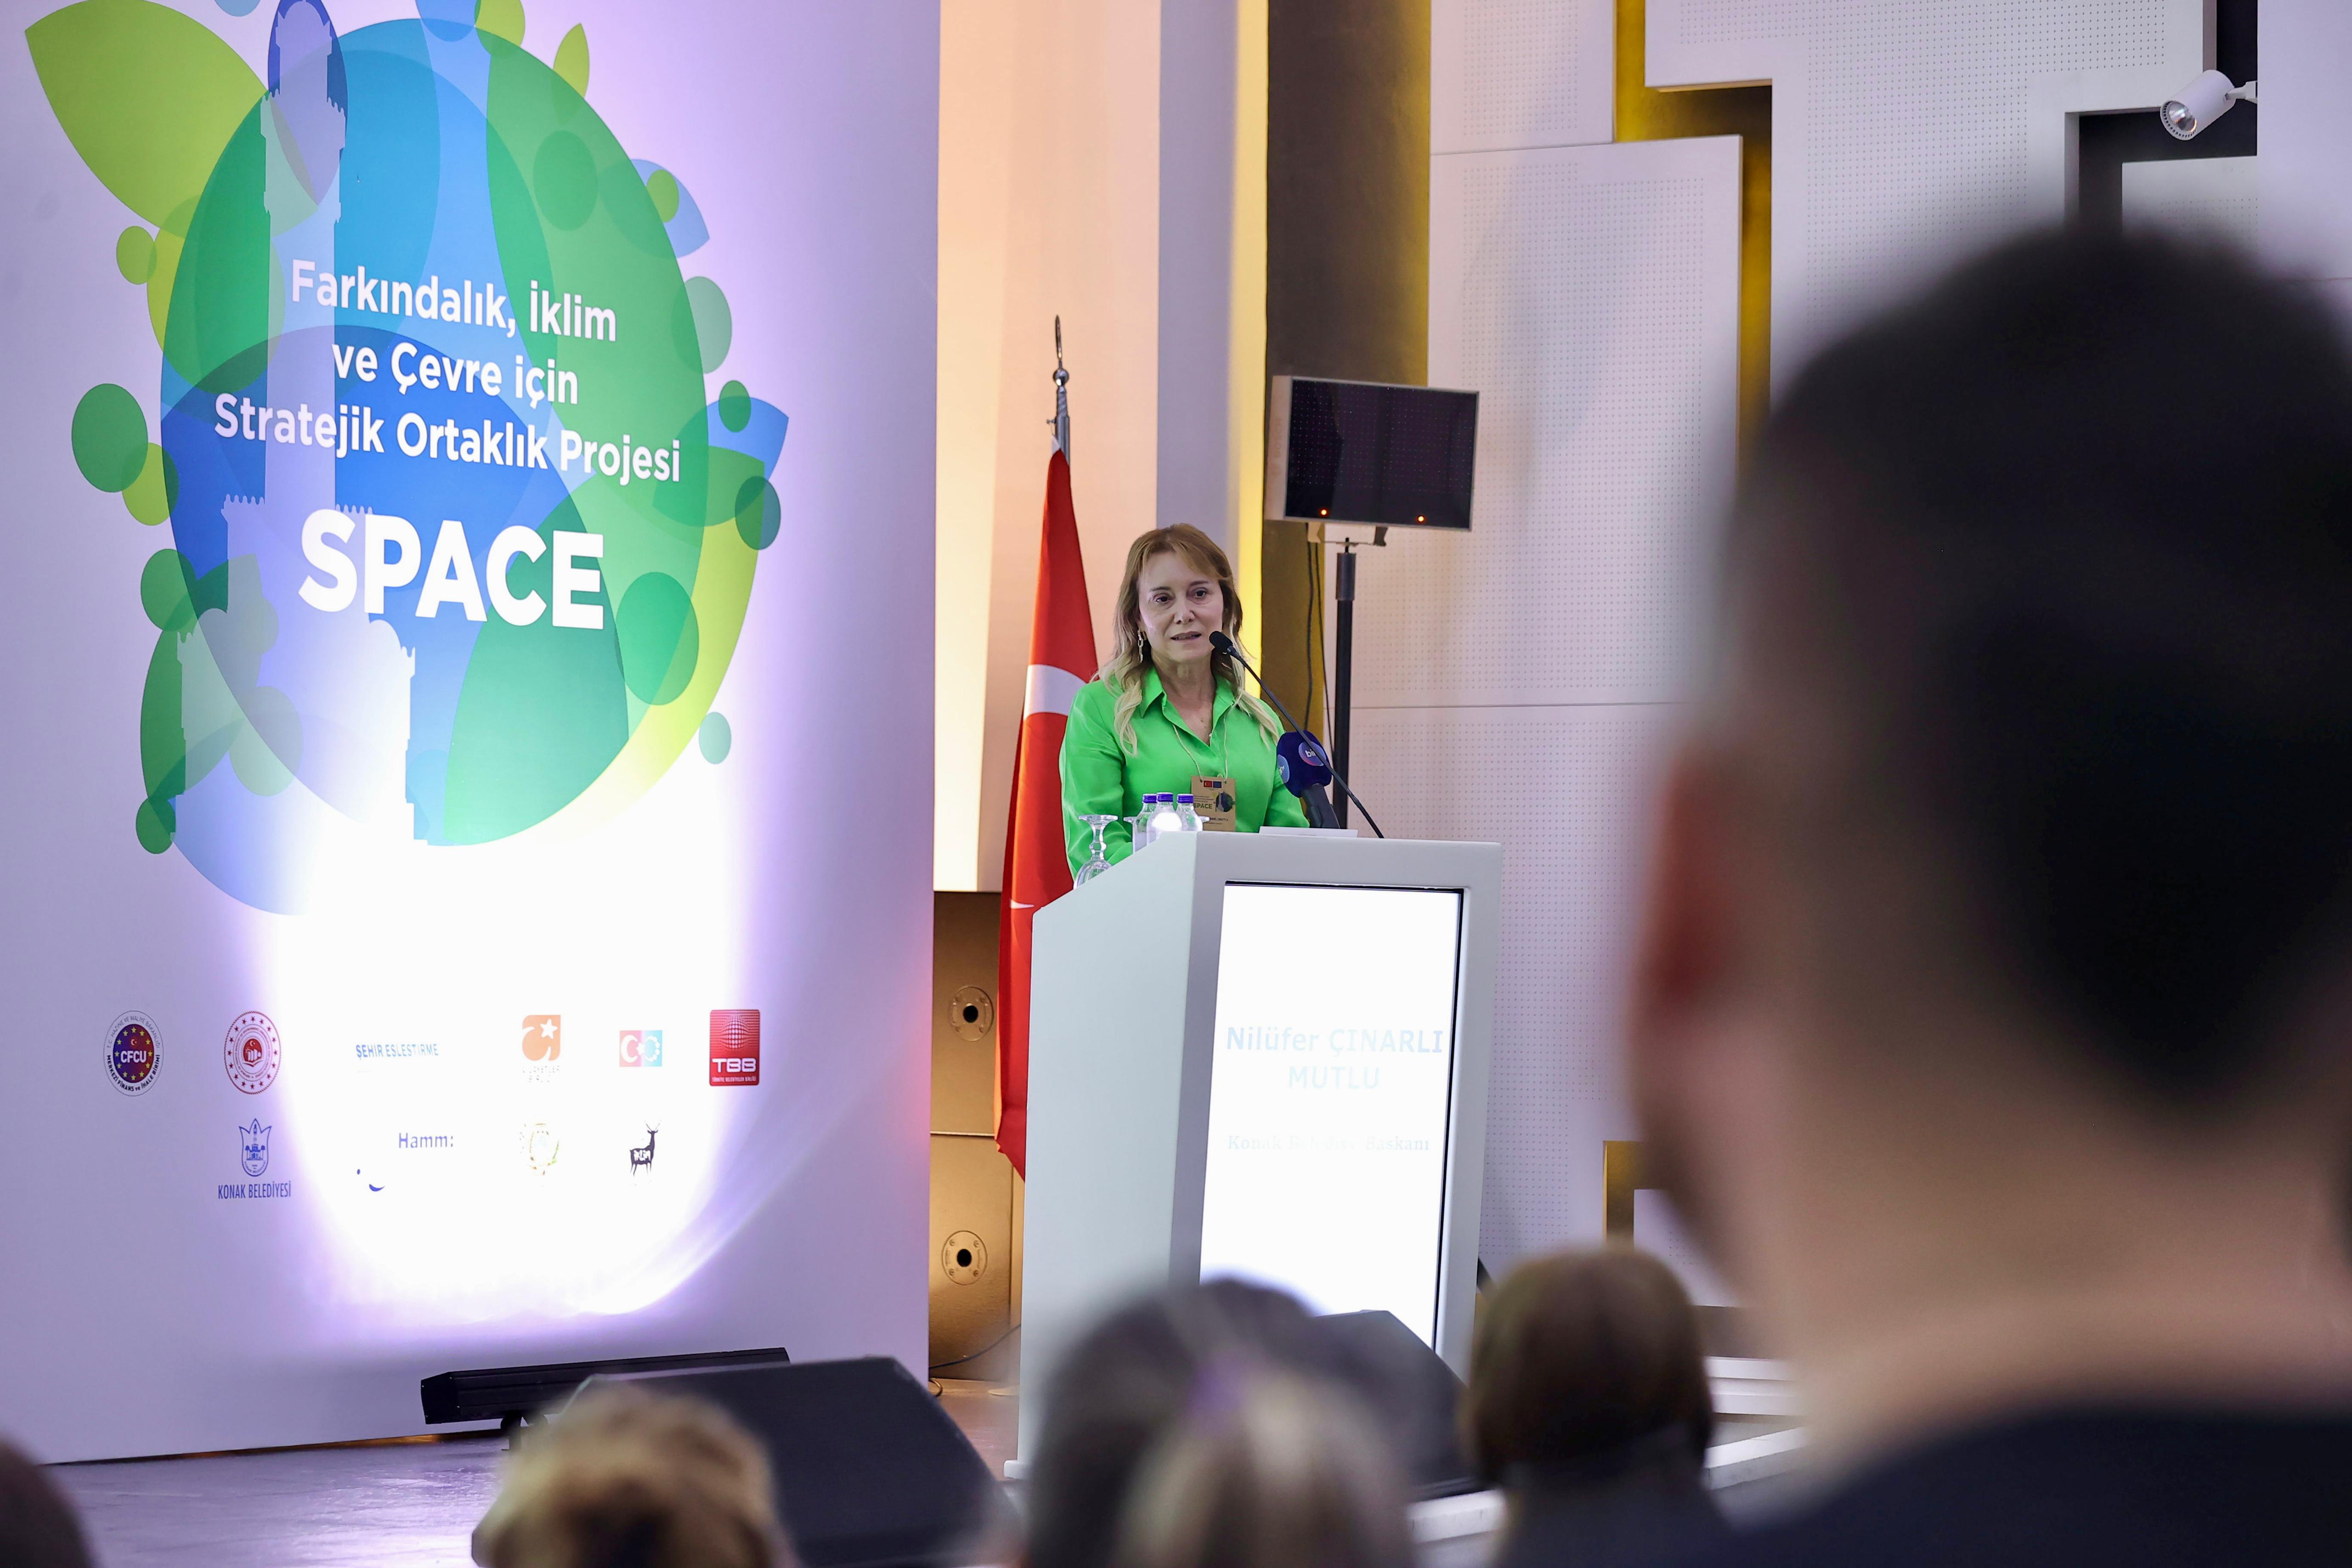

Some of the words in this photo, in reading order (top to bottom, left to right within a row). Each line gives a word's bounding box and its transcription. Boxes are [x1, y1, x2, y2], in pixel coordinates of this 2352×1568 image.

[291, 259, 516, 337] Farkındalık,
[530, 280, 616, 342] İklim
[331, 344, 378, 382] ve
[391, 341, 503, 395] Çevre
[514, 355, 578, 408] için
[214, 392, 384, 458] Stratejik
[396, 412, 548, 469] Ortaklık
[560, 430, 680, 485] Projesi
[298, 508, 604, 630] SPACE
[1227, 1027, 1319, 1051] Nilüfer
[1329, 1029, 1444, 1056] ÇINARLI
[120, 1050, 147, 1063] CFCU
[712, 1058, 757, 1073] TBB
[107, 1055, 119, 1082] MERKEZİ
[117, 1079, 134, 1091] FİNANS
[1287, 1066, 1380, 1089] MUTLU
[399, 1133, 453, 1148] Hamm:
[1227, 1135, 1282, 1151] Konak
[218, 1184, 246, 1199] KONAK
[249, 1180, 291, 1198] BELEDİYESİ
